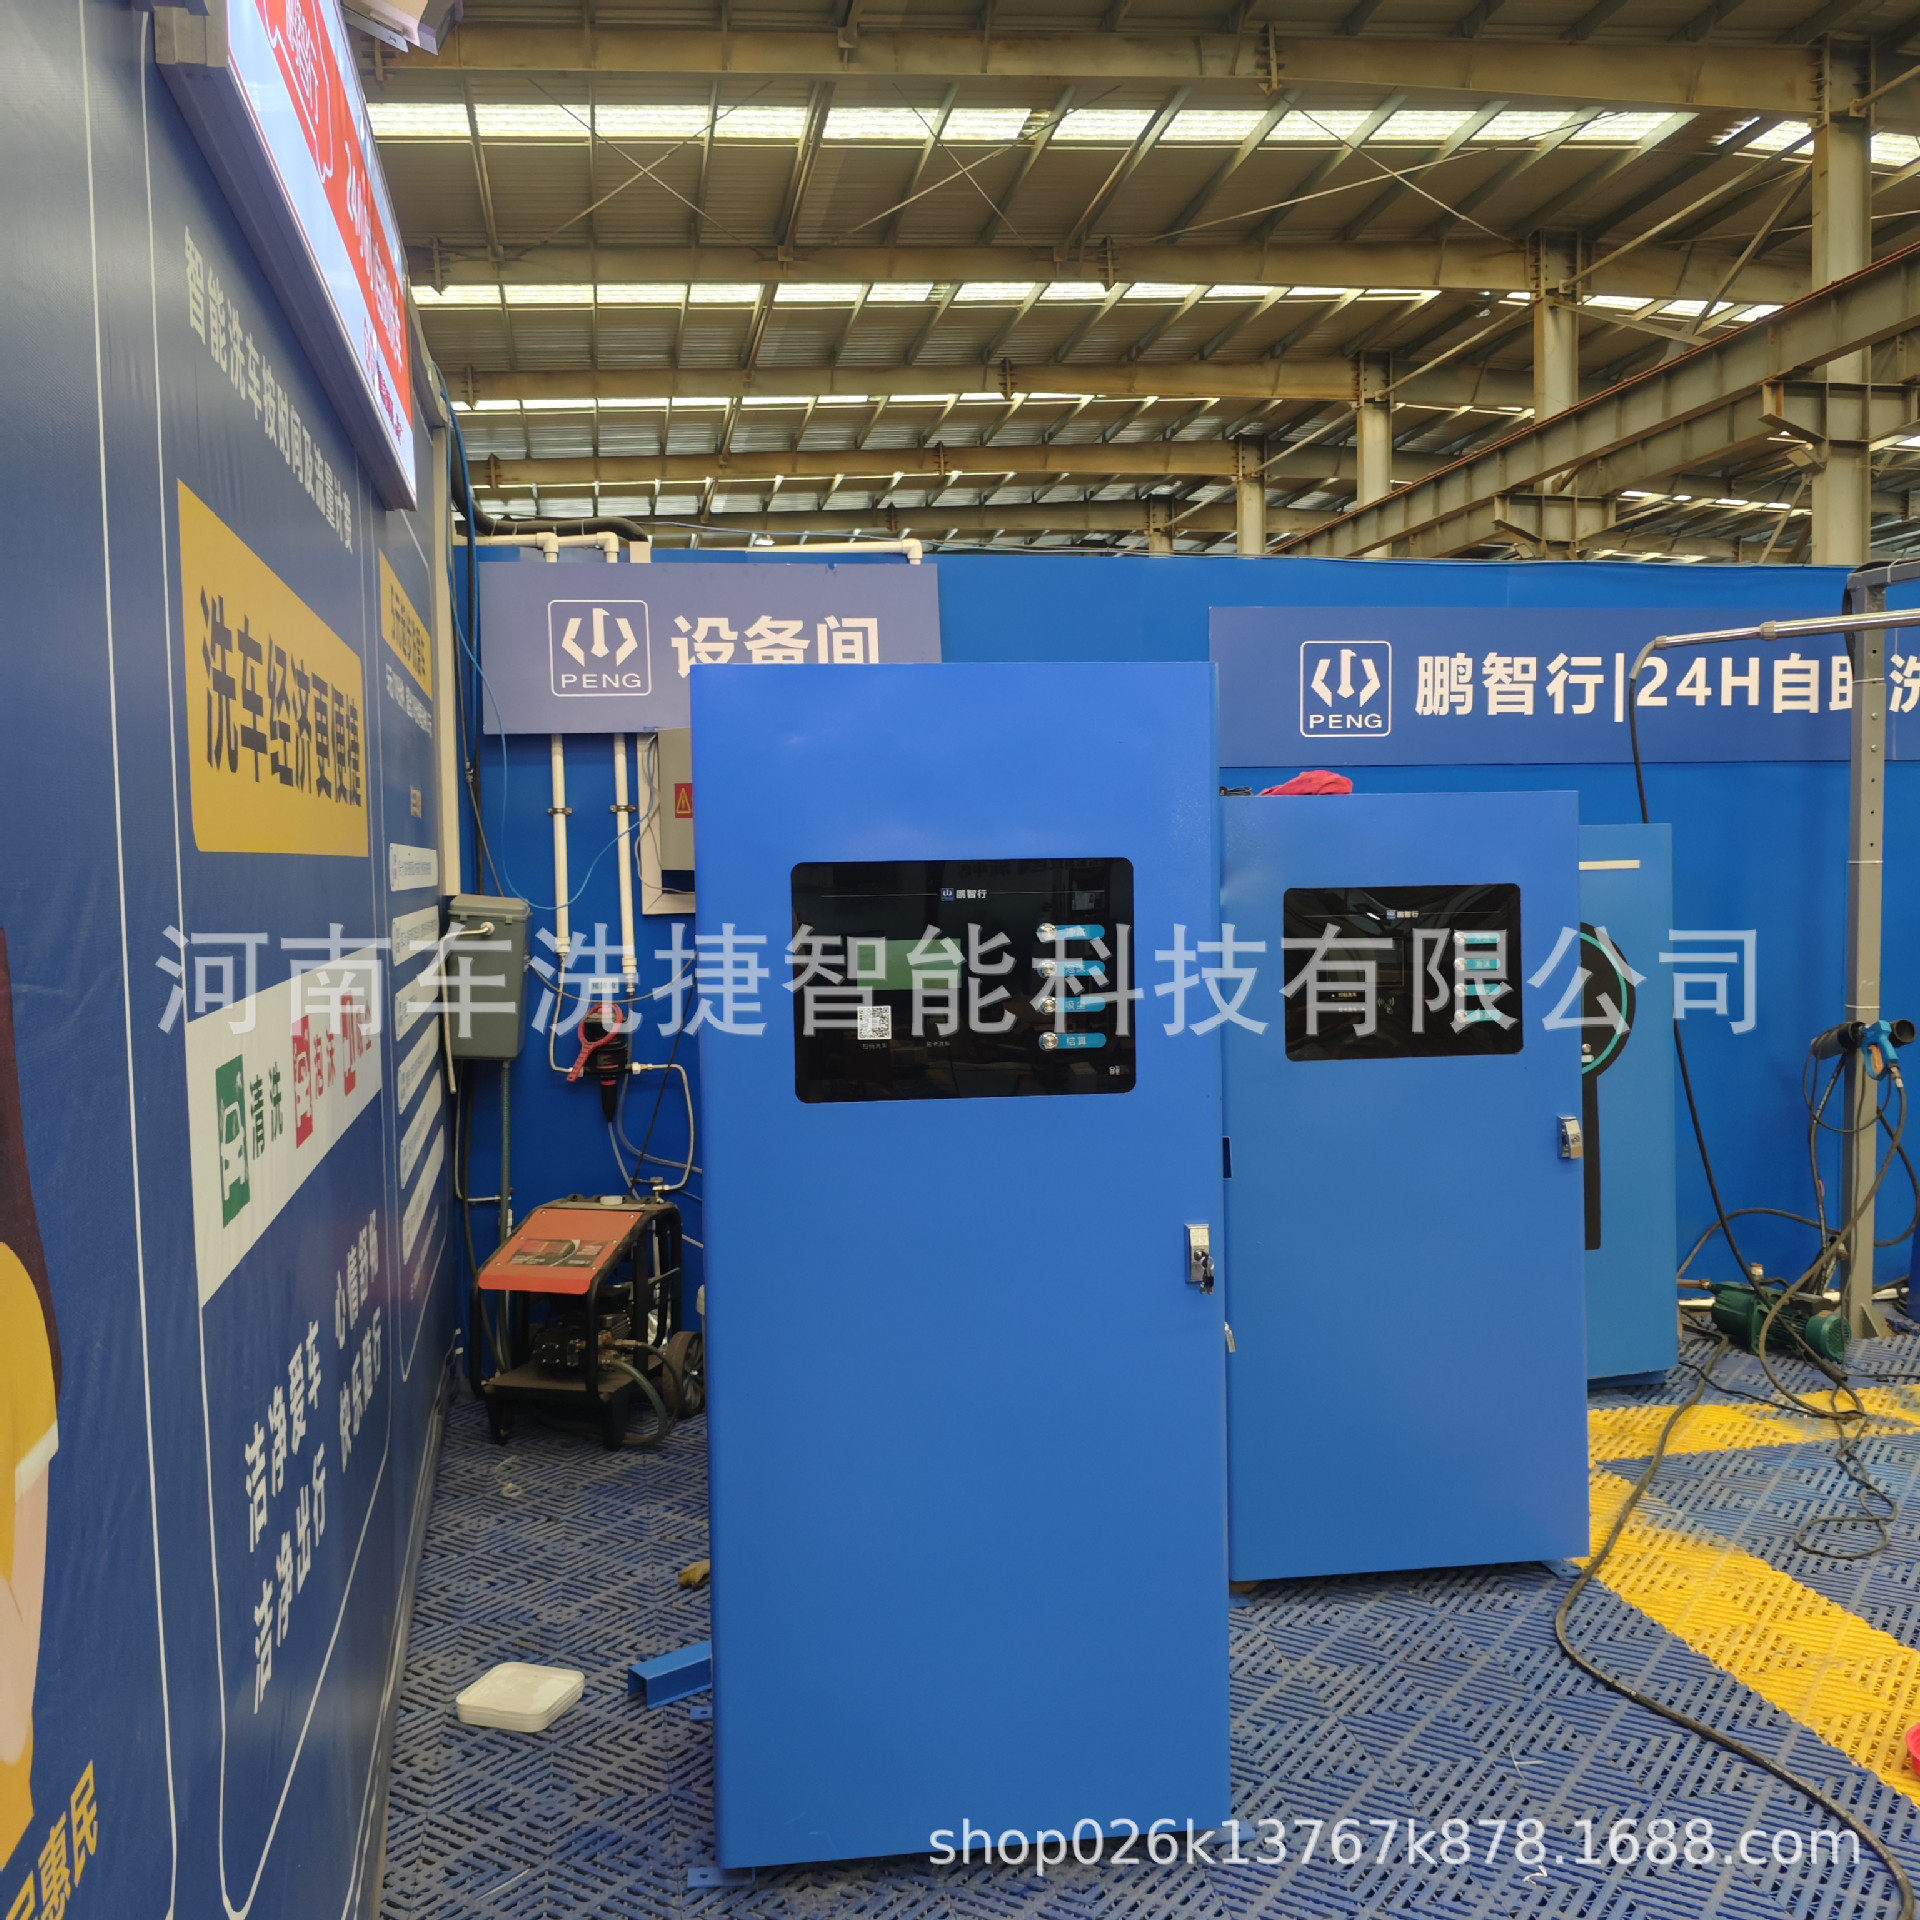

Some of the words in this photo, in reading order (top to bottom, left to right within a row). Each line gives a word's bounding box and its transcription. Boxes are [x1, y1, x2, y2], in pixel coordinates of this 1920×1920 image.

[200, 585, 362, 807] 洗车经济更便捷
[561, 673, 642, 689] PENG
[1308, 714, 1383, 730] PENG
[249, 1061, 284, 1161] 清洗
[244, 1319, 322, 1553] 洁净爱车
[253, 1442, 327, 1716] 洁净出行
